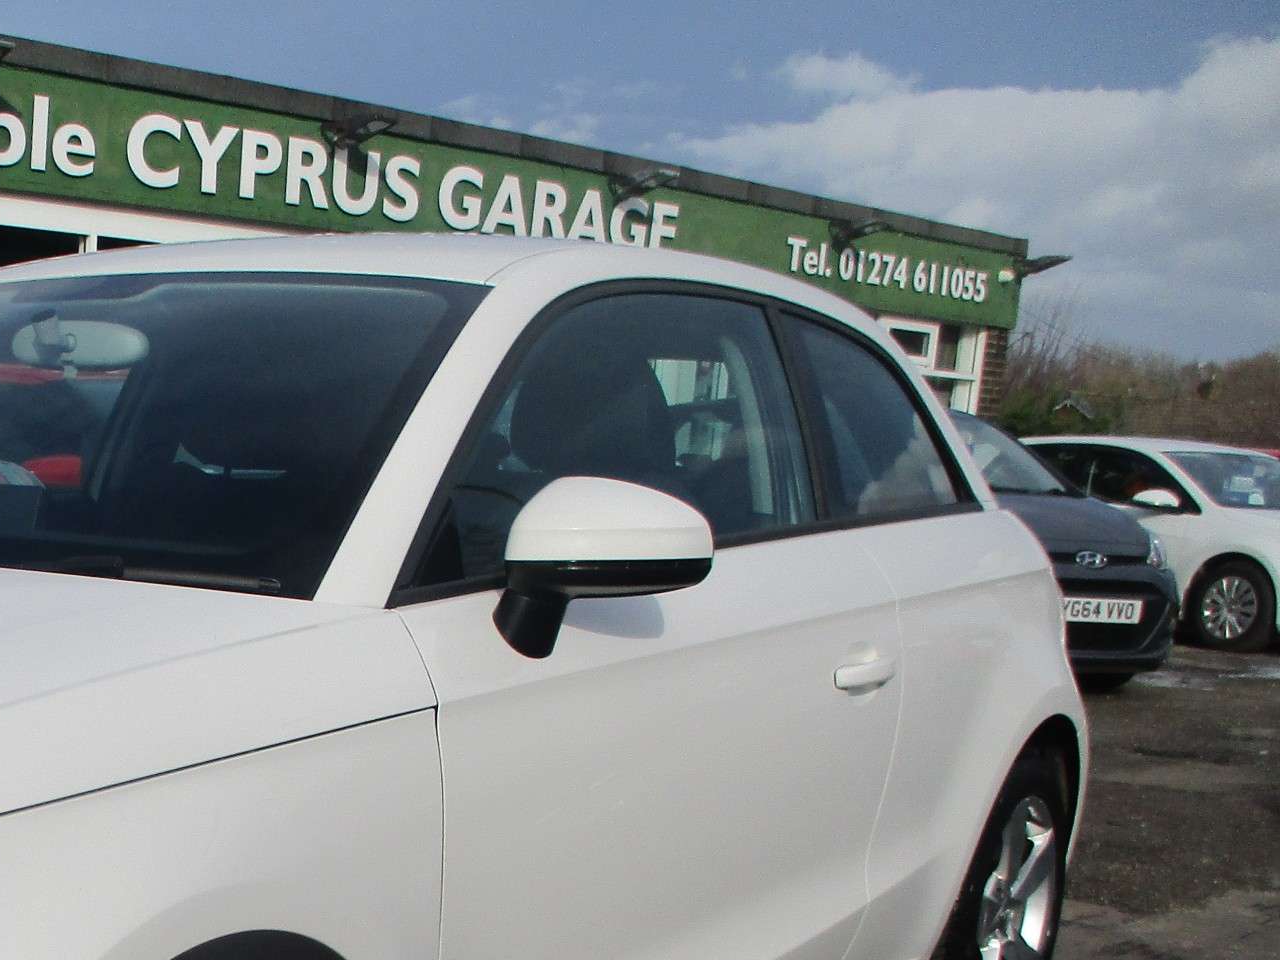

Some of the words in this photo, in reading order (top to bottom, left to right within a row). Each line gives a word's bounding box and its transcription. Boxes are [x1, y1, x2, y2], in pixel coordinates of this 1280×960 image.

[126, 113, 421, 223] CYPRUS
[438, 165, 680, 248] GARAGE
[787, 236, 832, 277] Tel.
[839, 247, 908, 289] 01274
[913, 260, 988, 303] 611055
